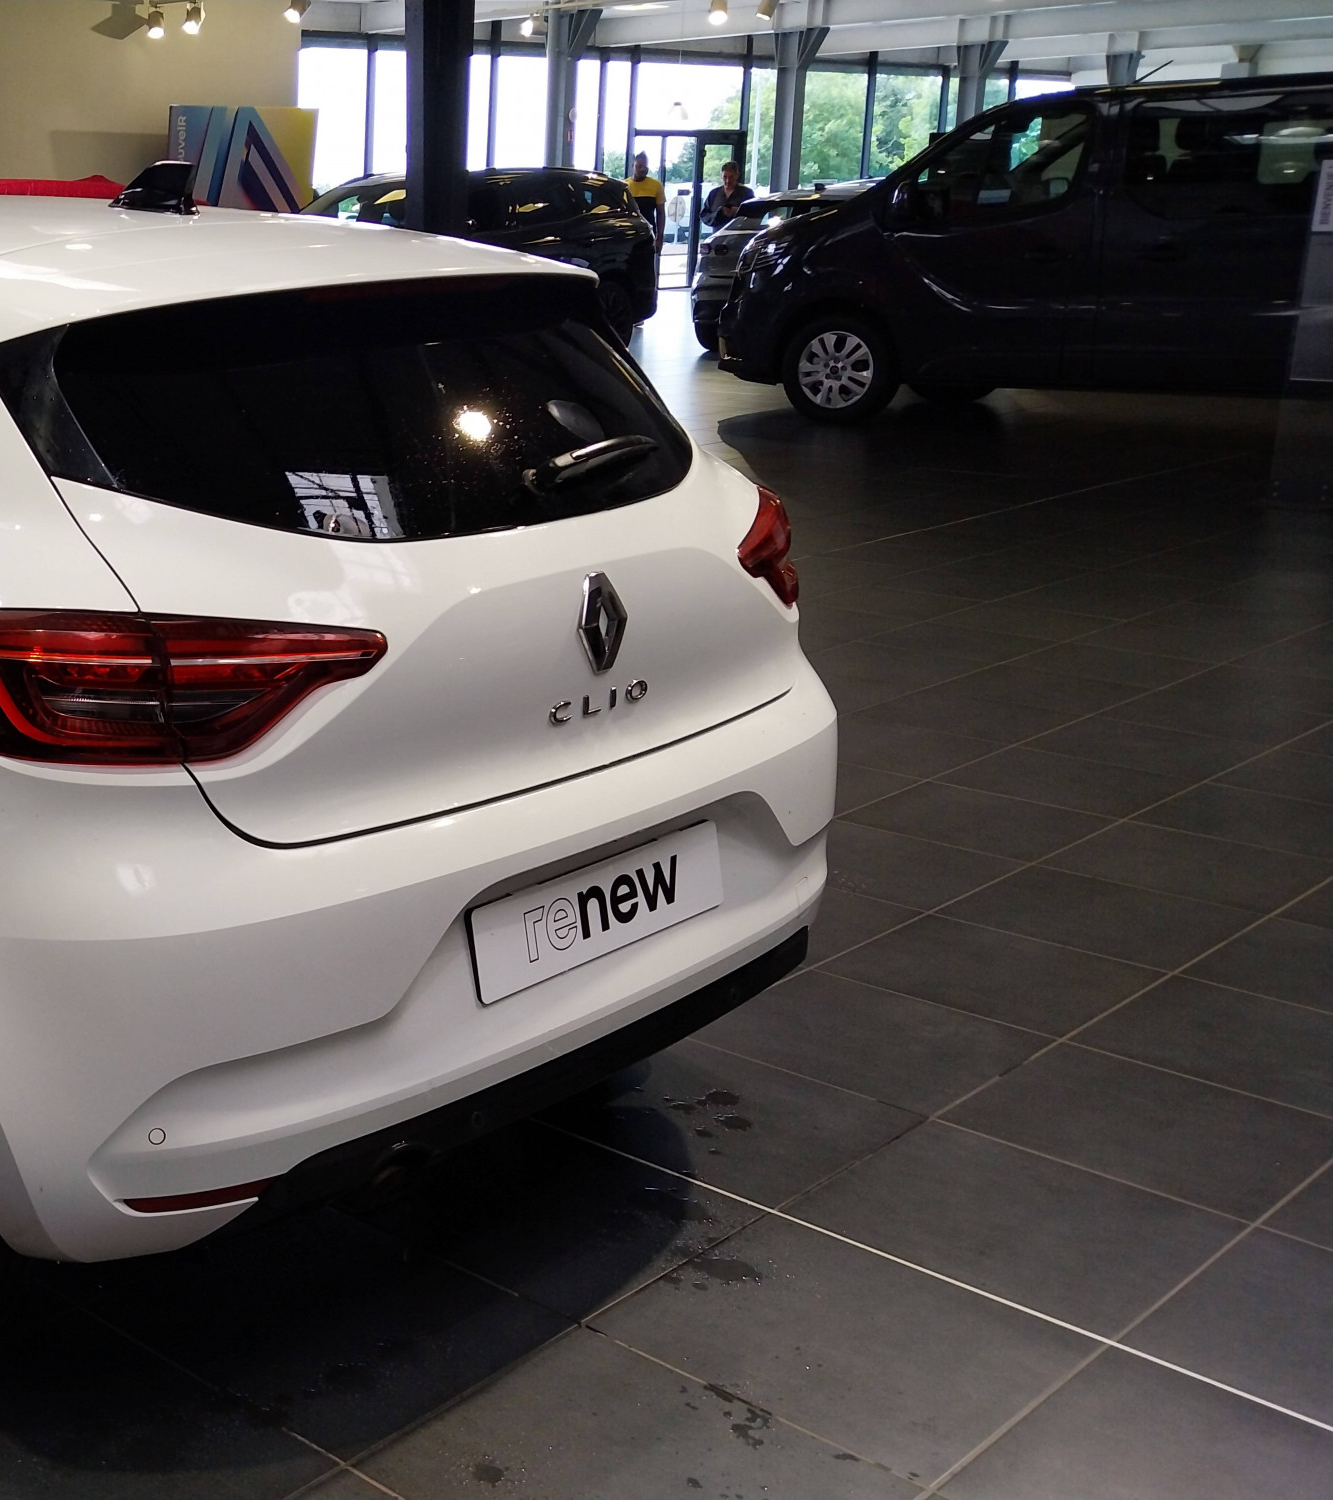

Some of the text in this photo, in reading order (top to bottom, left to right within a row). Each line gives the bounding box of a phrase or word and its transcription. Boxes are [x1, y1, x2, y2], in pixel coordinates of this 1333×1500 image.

[176, 115, 187, 161] uvelR
[549, 679, 647, 726] CLIO
[523, 854, 678, 963] renew
